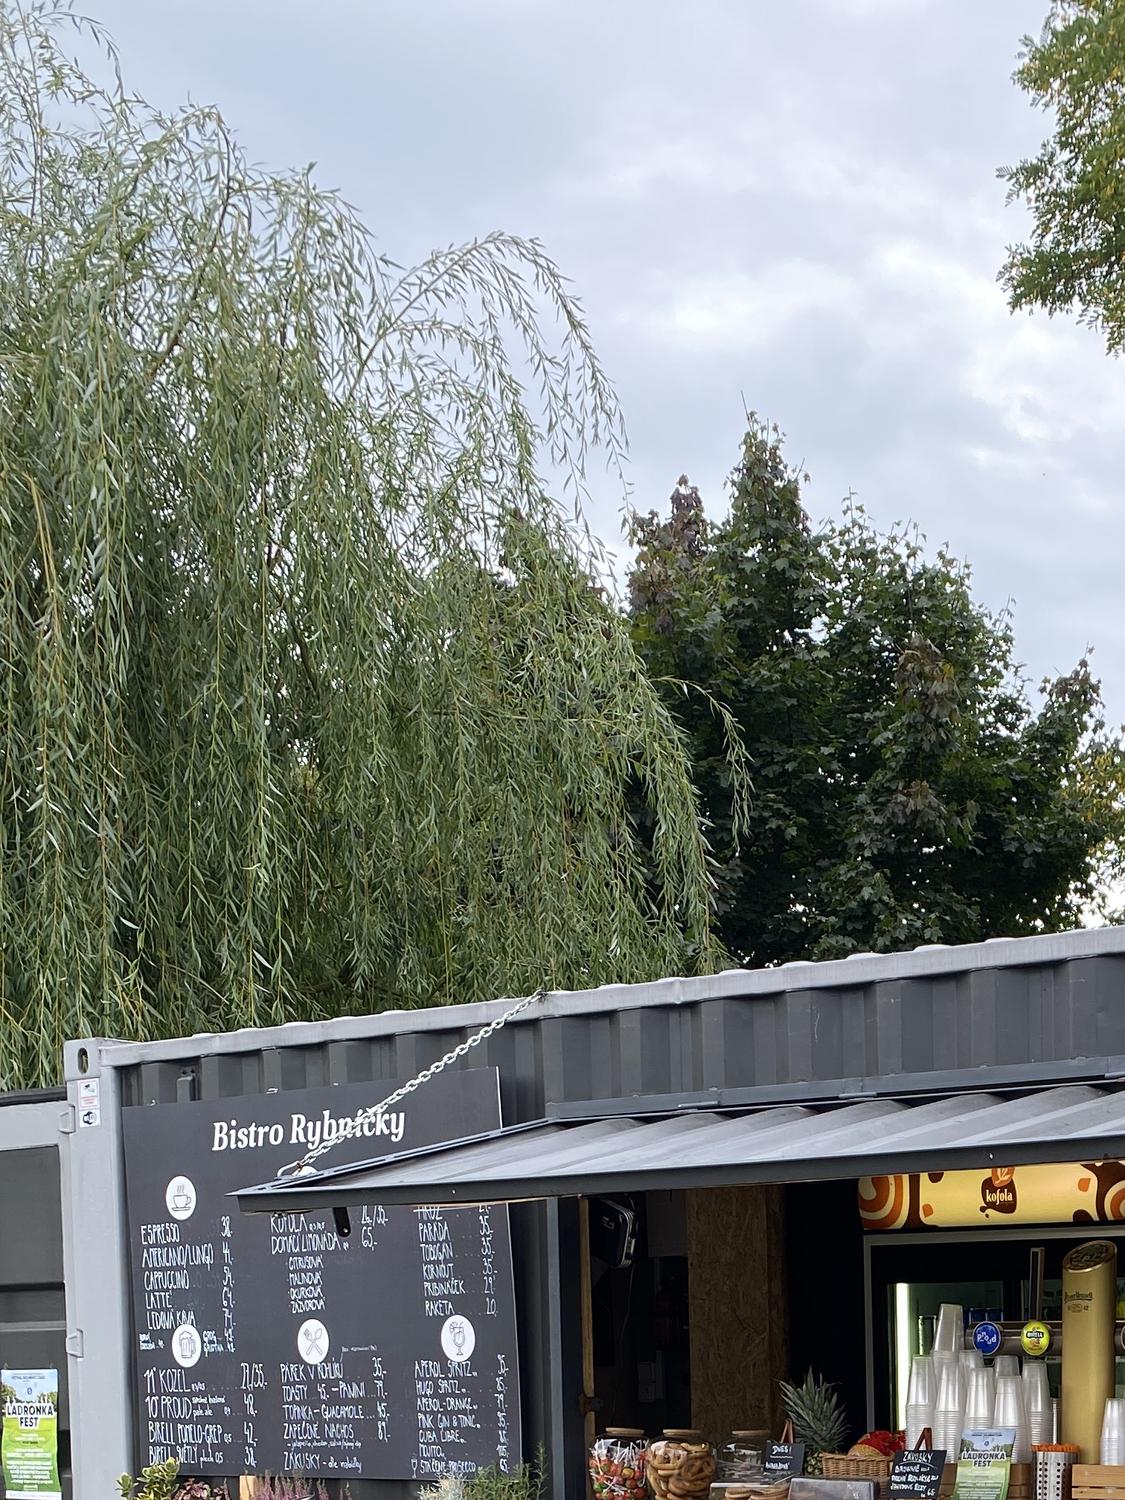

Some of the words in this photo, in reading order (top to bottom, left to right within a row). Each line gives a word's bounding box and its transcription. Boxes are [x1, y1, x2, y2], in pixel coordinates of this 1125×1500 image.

[212, 1119, 284, 1151] Bistro
[985, 1188, 1014, 1205] kofola
[140, 1222, 181, 1245] ESPRESSO
[144, 1269, 190, 1291] CAPPUCCINO
[422, 1263, 454, 1281] KORNOUT
[424, 1300, 455, 1317] RAKETA
[977, 1331, 998, 1347] proud
[280, 1363, 306, 1384] PÁREK
[306, 1365, 315, 1380] V
[415, 1360, 446, 1379] APEROL
[159, 1369, 191, 1392] KOZEL
[416, 1380, 434, 1397] HUGO
[282, 1385, 308, 1402] TOASTY
[6, 1403, 54, 1417] LADRONKA
[160, 1395, 192, 1419] PROUD
[19, 1416, 39, 1428] FEST
[148, 1421, 176, 1445] BIRELL
[324, 1423, 354, 1439] NACHOS
[283, 1451, 321, 1471] ZÁKUSKY
[962, 1451, 1006, 1461] LADRONKA
[973, 1460, 992, 1468] FEST
